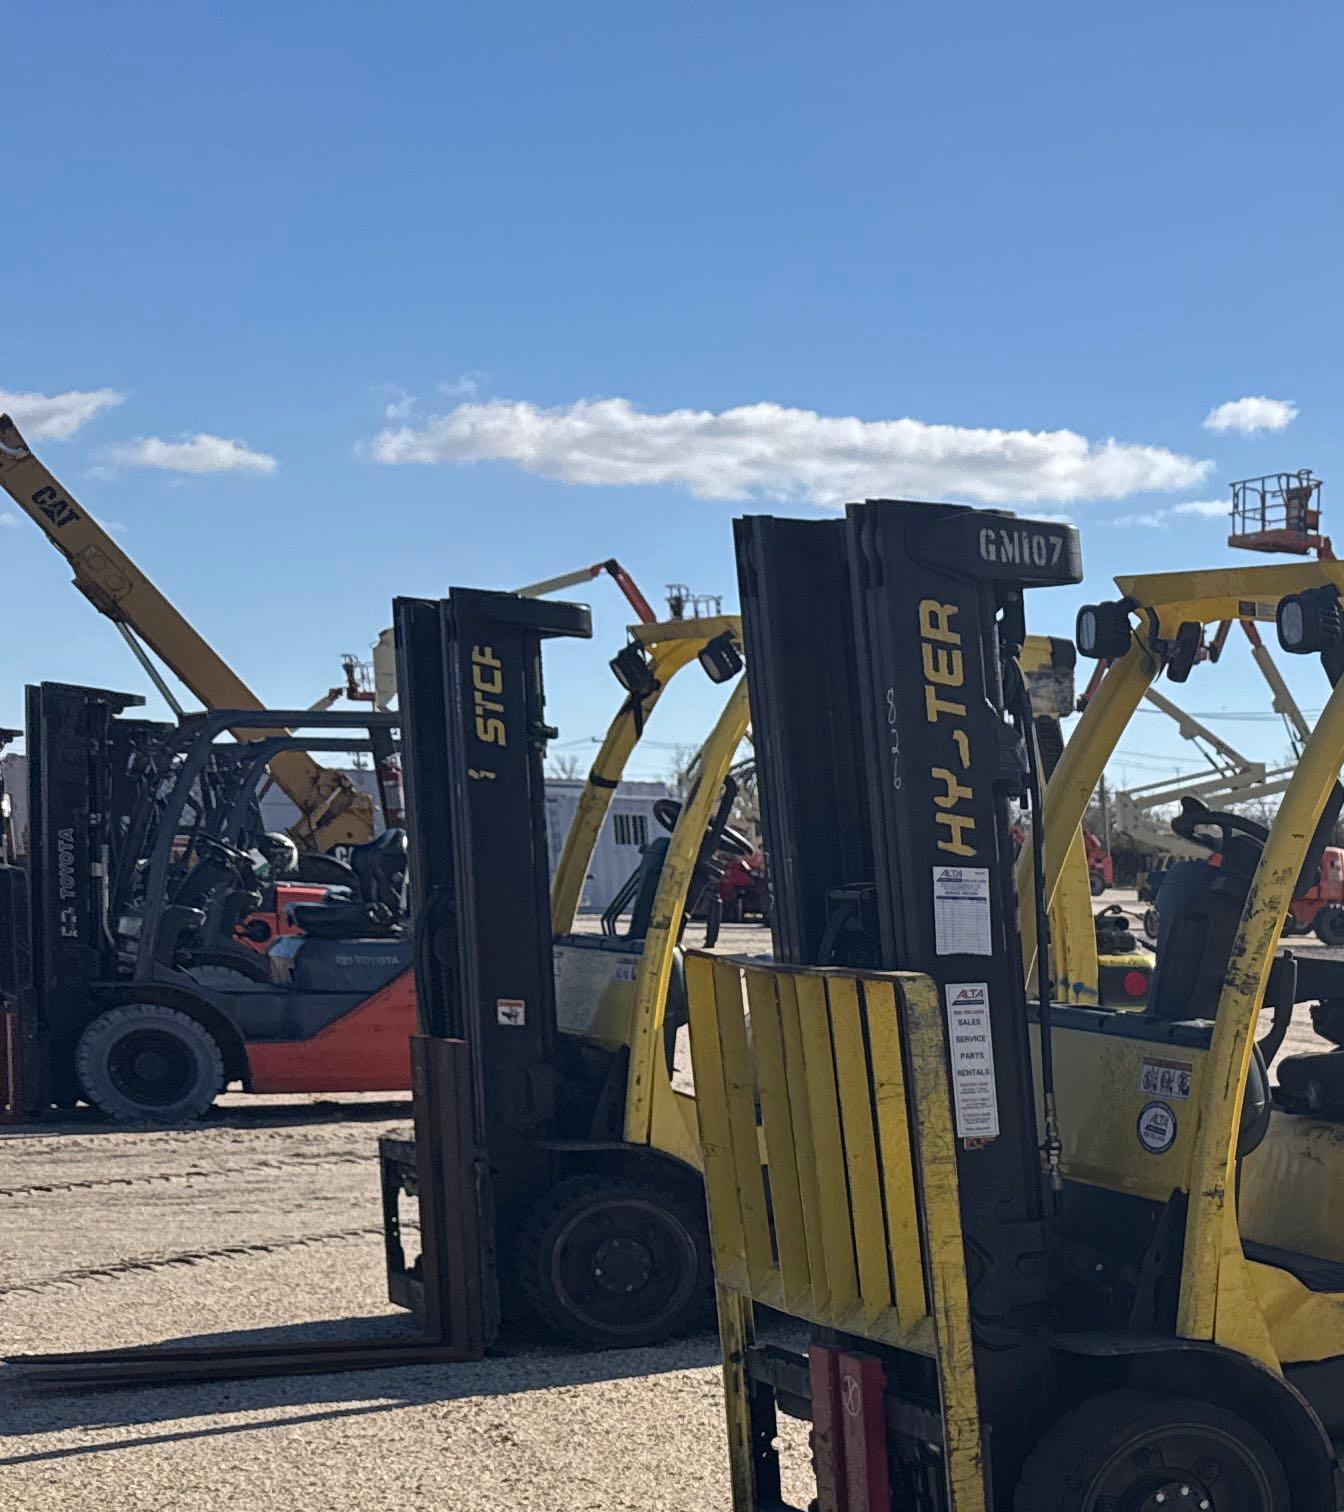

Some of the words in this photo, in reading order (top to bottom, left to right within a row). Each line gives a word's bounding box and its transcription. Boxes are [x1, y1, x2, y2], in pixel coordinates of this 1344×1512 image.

[31, 486, 81, 528] CAT
[58, 827, 77, 900] TOYOTA
[355, 955, 400, 965] TOYOTA
[957, 988, 984, 999] ALTA
[958, 1018, 981, 1026] SALES
[955, 1034, 986, 1042] SERVICE
[957, 1068, 990, 1077] RENTALS
